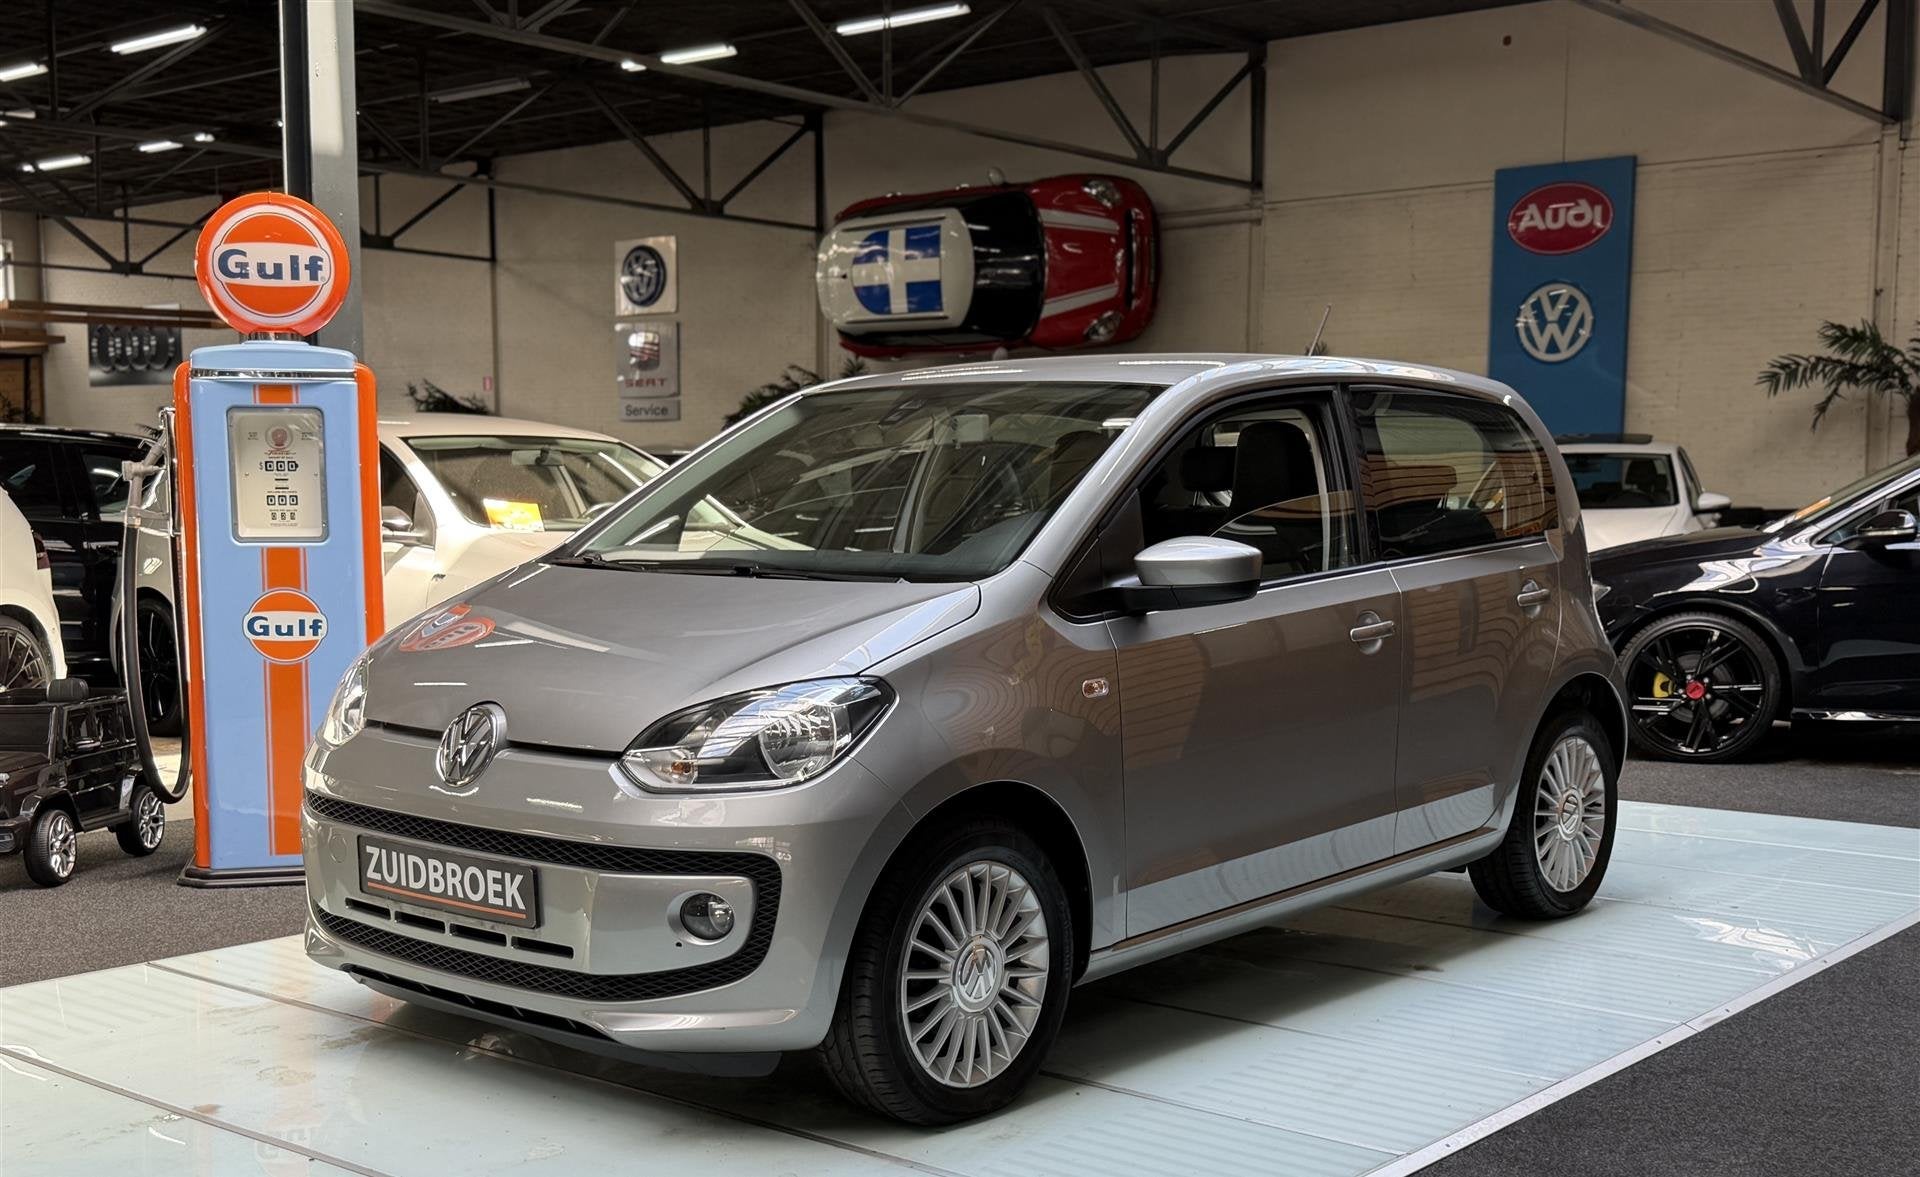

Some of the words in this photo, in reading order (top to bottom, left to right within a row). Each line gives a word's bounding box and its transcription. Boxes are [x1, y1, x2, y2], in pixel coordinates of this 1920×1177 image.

[217, 249, 326, 281] Gulf
[1516, 282, 1593, 363] VW
[625, 376, 668, 388] SEAT
[625, 404, 669, 416] Service
[247, 616, 322, 636] Gulf
[437, 706, 496, 787] VW
[365, 844, 526, 910] ZUIDBROEK
